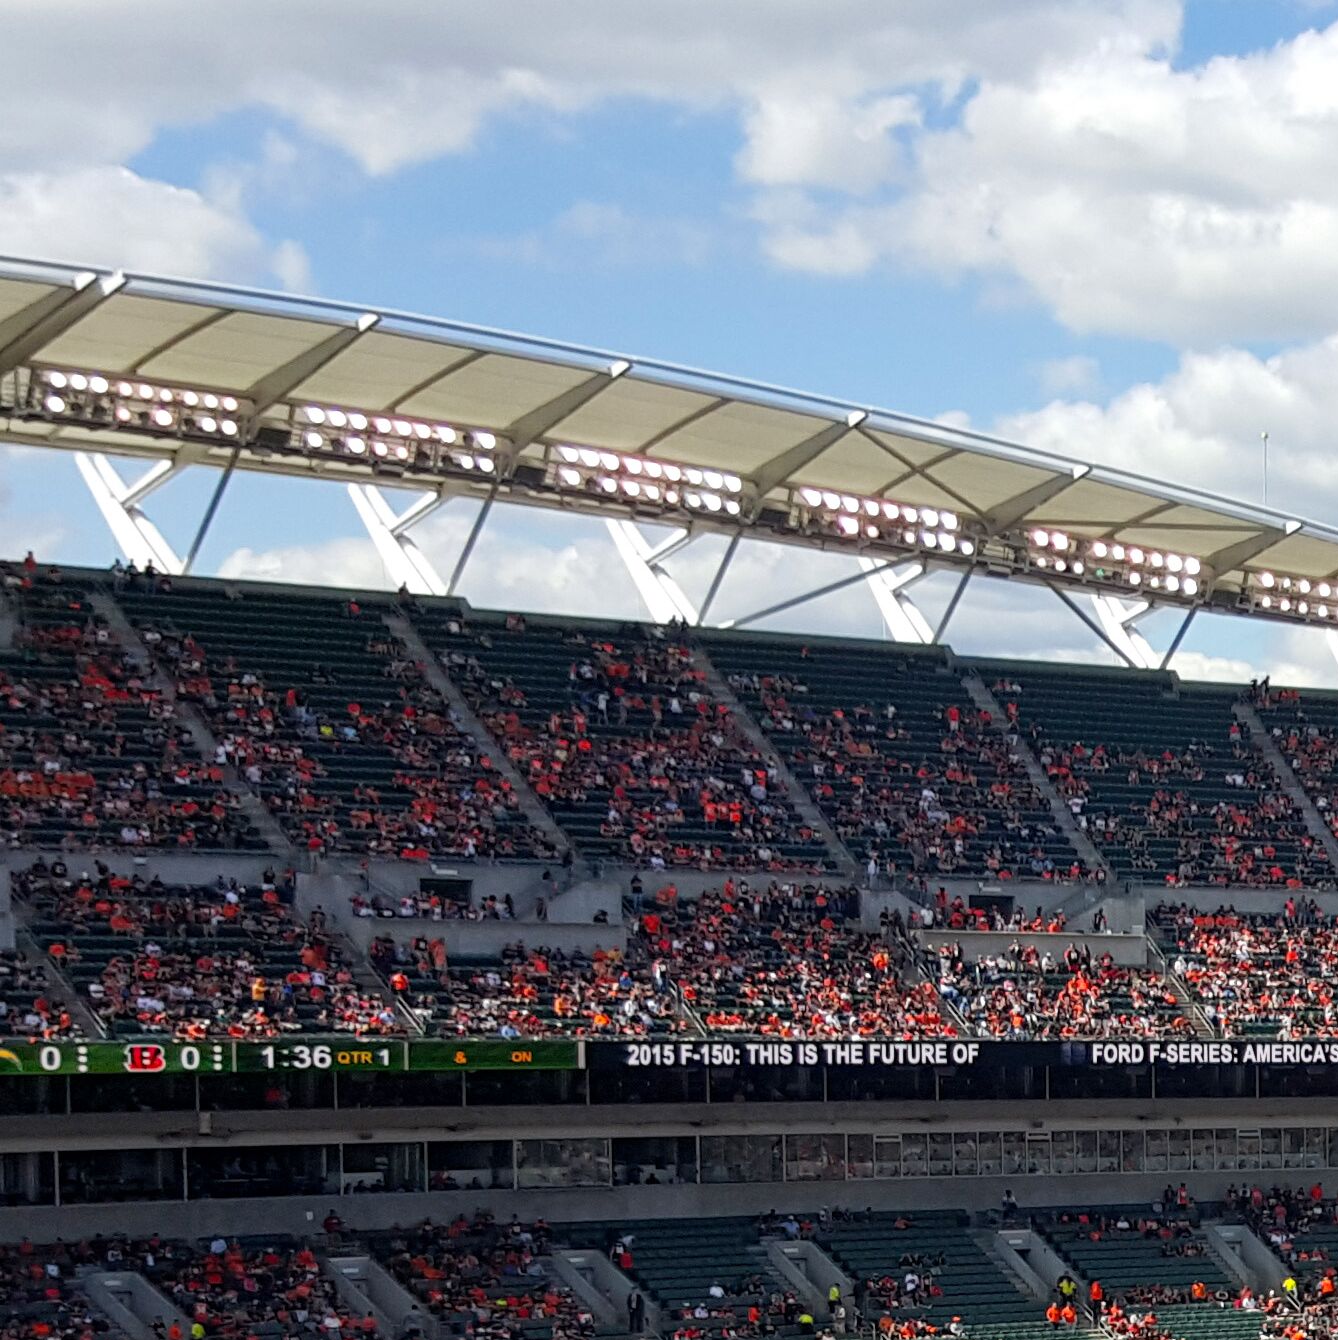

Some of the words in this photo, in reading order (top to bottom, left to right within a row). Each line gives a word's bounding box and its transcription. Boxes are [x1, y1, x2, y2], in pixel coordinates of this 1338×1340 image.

[40, 1046, 61, 1070] 0
[181, 1046, 200, 1069] 0
[261, 1046, 332, 1069] 1:36
[337, 1053, 373, 1064] QTR
[378, 1049, 391, 1066] 1
[511, 1052, 532, 1063] ON
[627, 1044, 675, 1066] 2015
[679, 1044, 741, 1065] F-150:
[746, 1044, 793, 1065] THIS
[799, 1044, 818, 1064] IS
[824, 1044, 863, 1064] THE
[869, 1044, 947, 1064] FUTURE
[953, 1043, 979, 1064] OF
[1092, 1044, 1144, 1064] FORD
[1150, 1044, 1238, 1064] F-SERIES:
